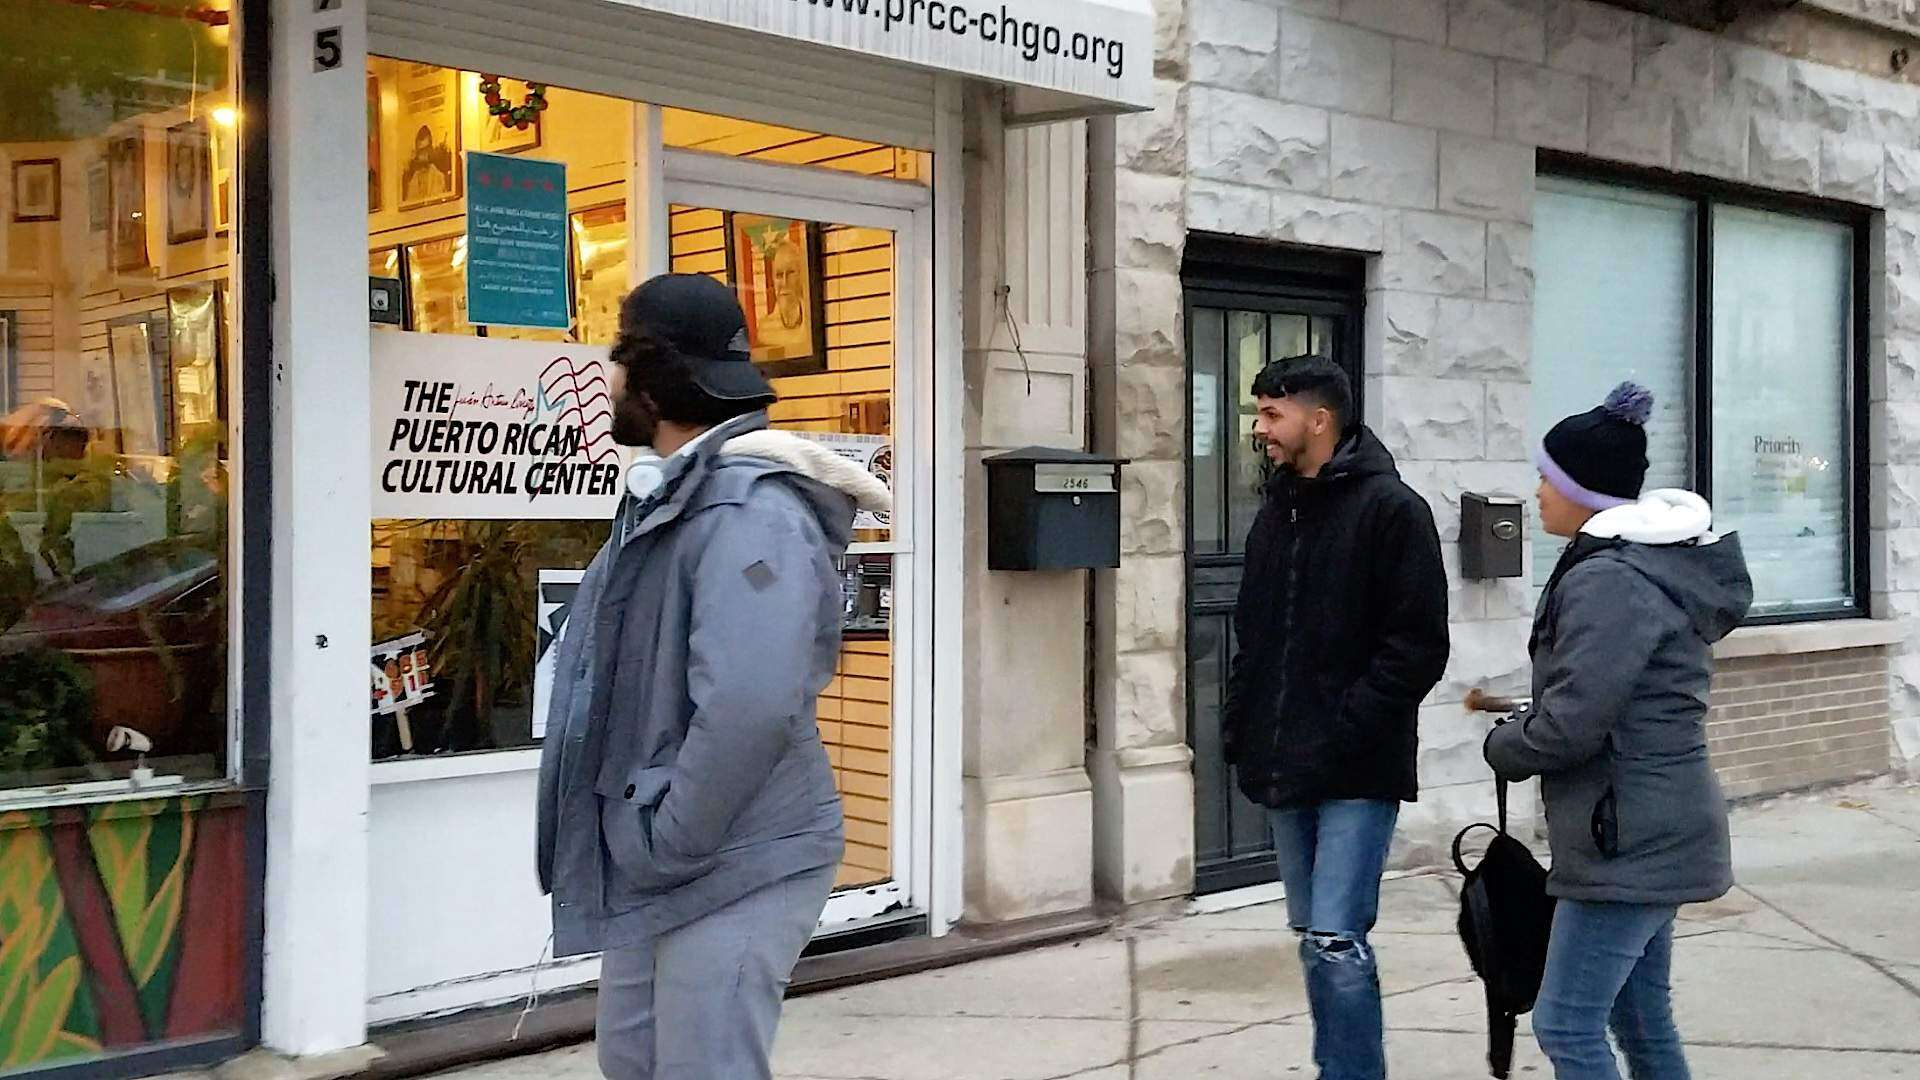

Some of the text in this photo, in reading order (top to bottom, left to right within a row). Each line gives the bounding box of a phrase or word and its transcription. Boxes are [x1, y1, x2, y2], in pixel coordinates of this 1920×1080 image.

[790, 0, 1124, 78] w.prcc-chgo.org
[403, 380, 454, 414] THE
[389, 418, 582, 457] PUERTO RICAN
[382, 459, 620, 496] CULTURAL CENTER
[1063, 478, 1089, 489] 2546
